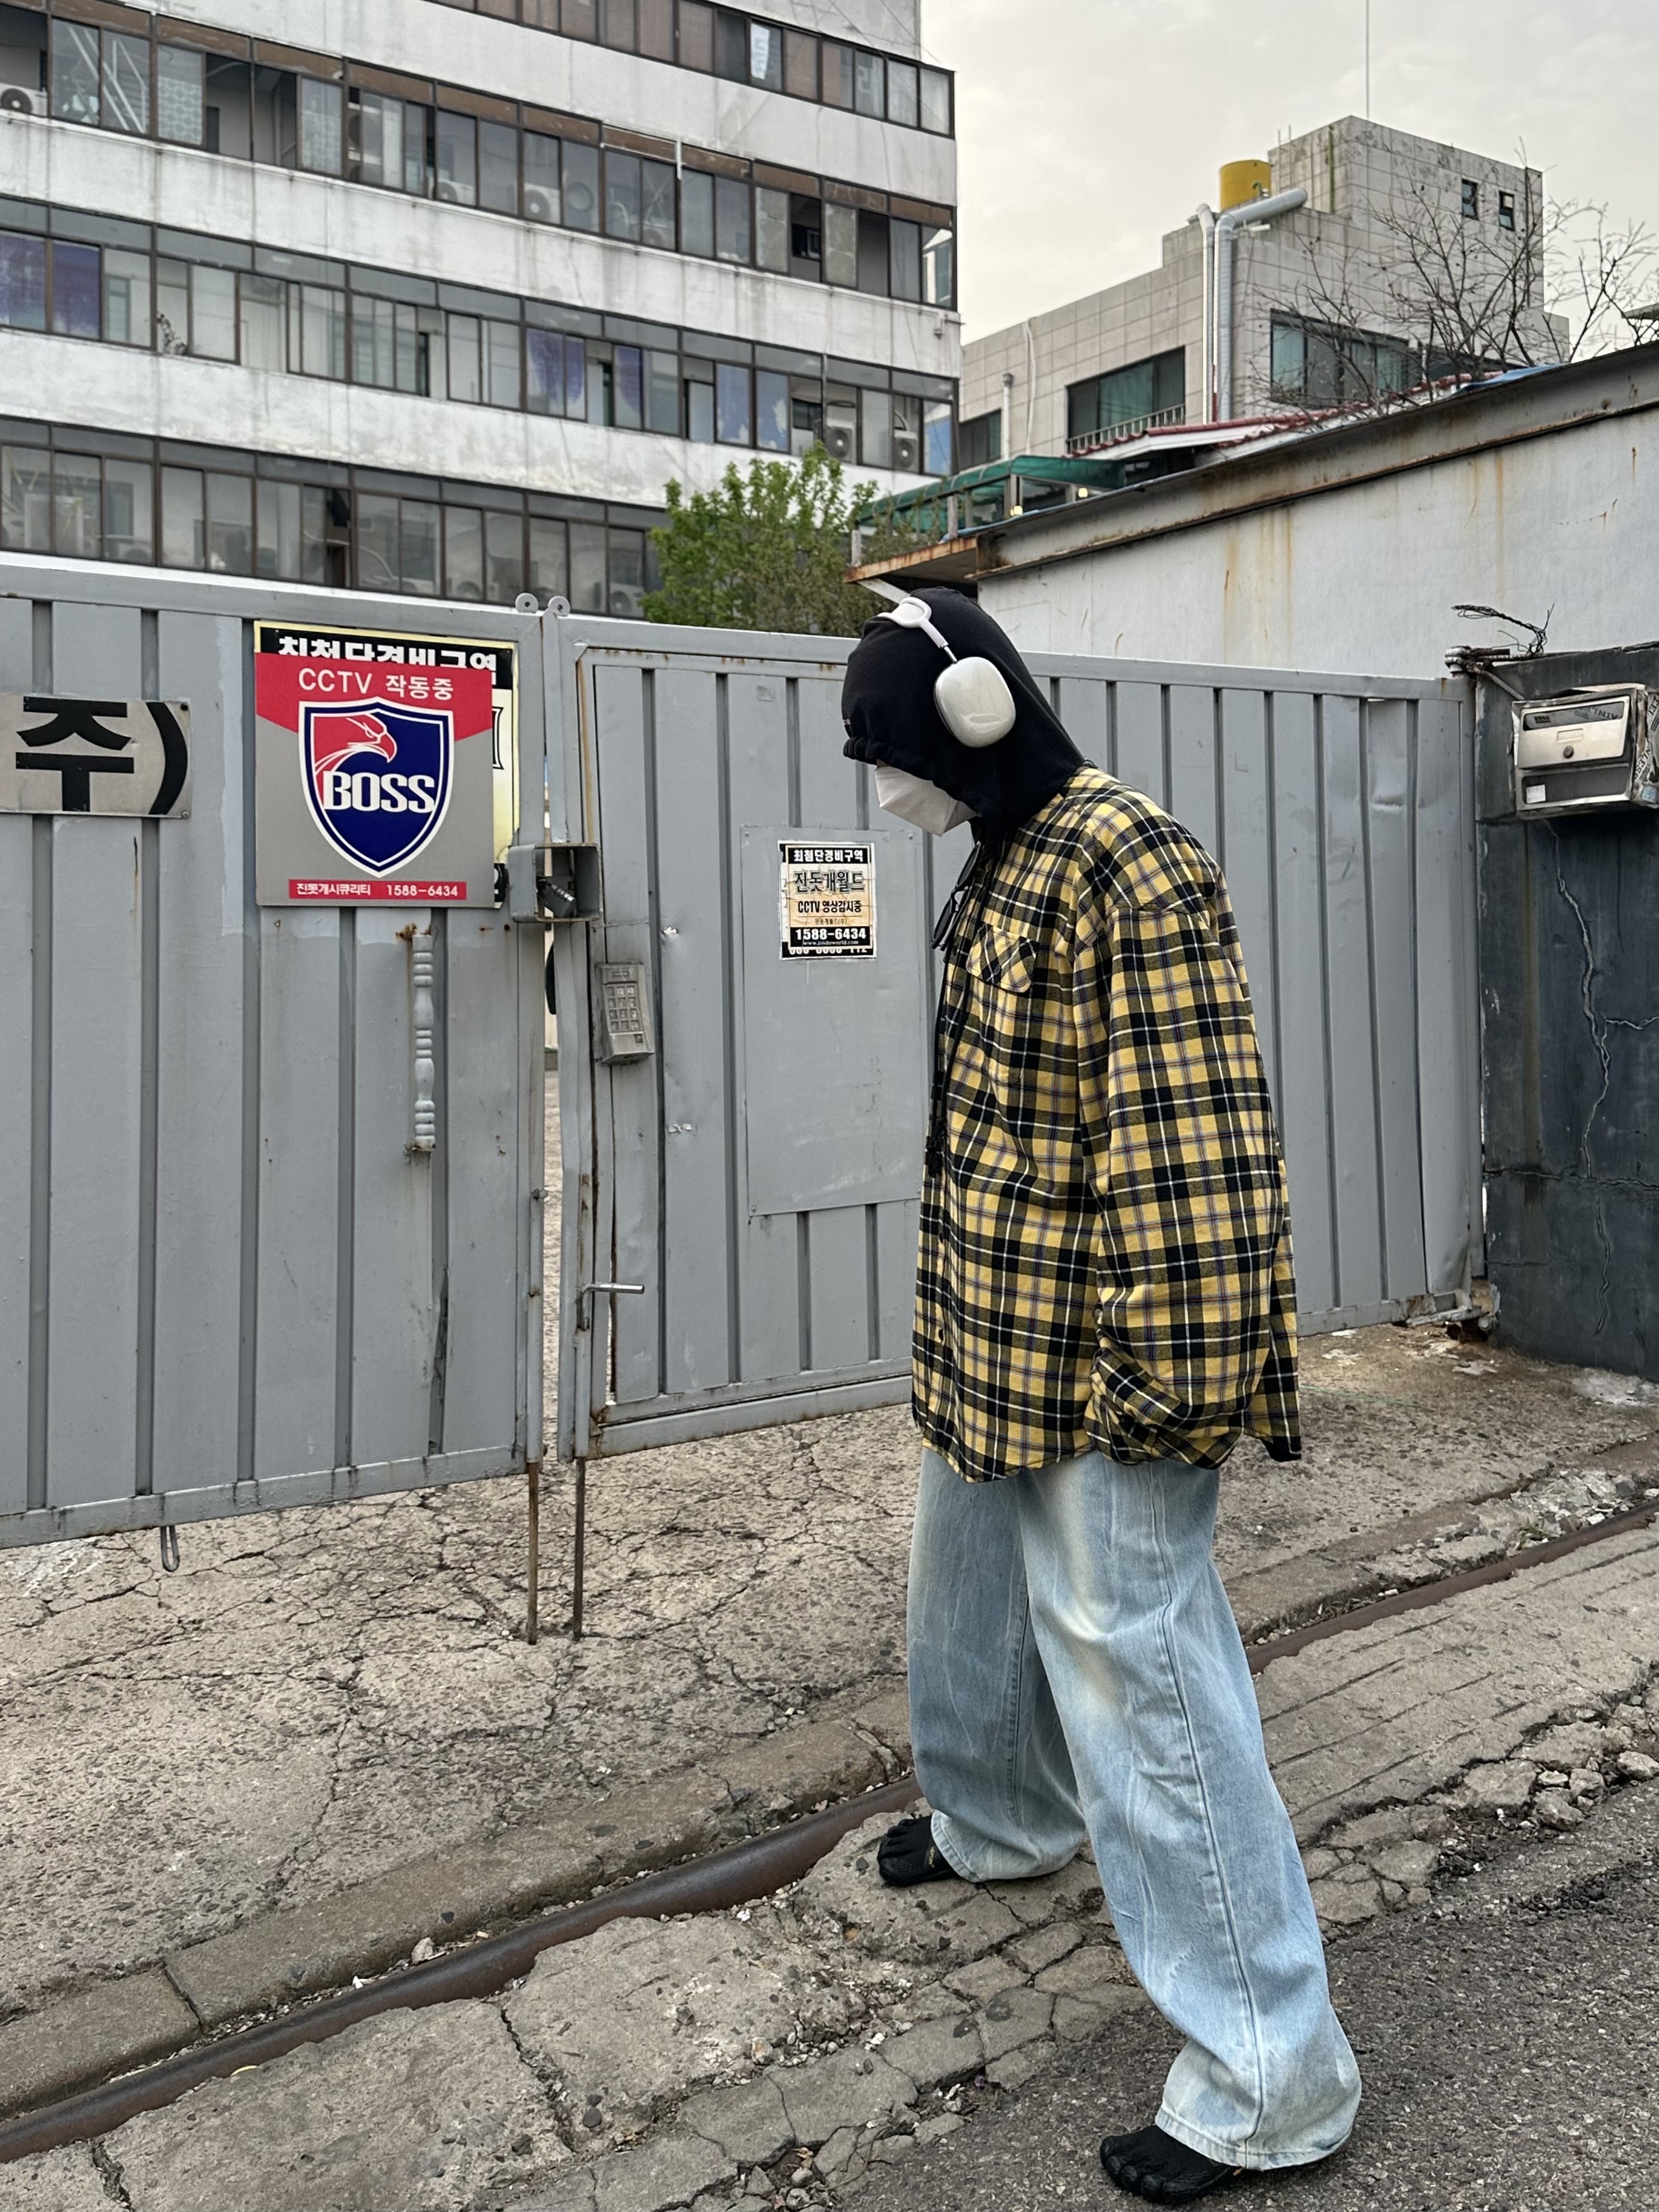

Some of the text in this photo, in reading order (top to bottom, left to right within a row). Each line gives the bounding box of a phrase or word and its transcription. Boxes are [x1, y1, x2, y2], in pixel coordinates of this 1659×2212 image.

[298, 668, 454, 701] CCTV 작동중
[322, 771, 435, 813] BOSS
[793, 849, 863, 863] 최첨단경비구역
[793, 869, 865, 894] 진돗개월드
[386, 884, 458, 897] 1588-6434
[797, 900, 862, 913] CCTV 영상감시중
[795, 928, 866, 940] 1588-6434
